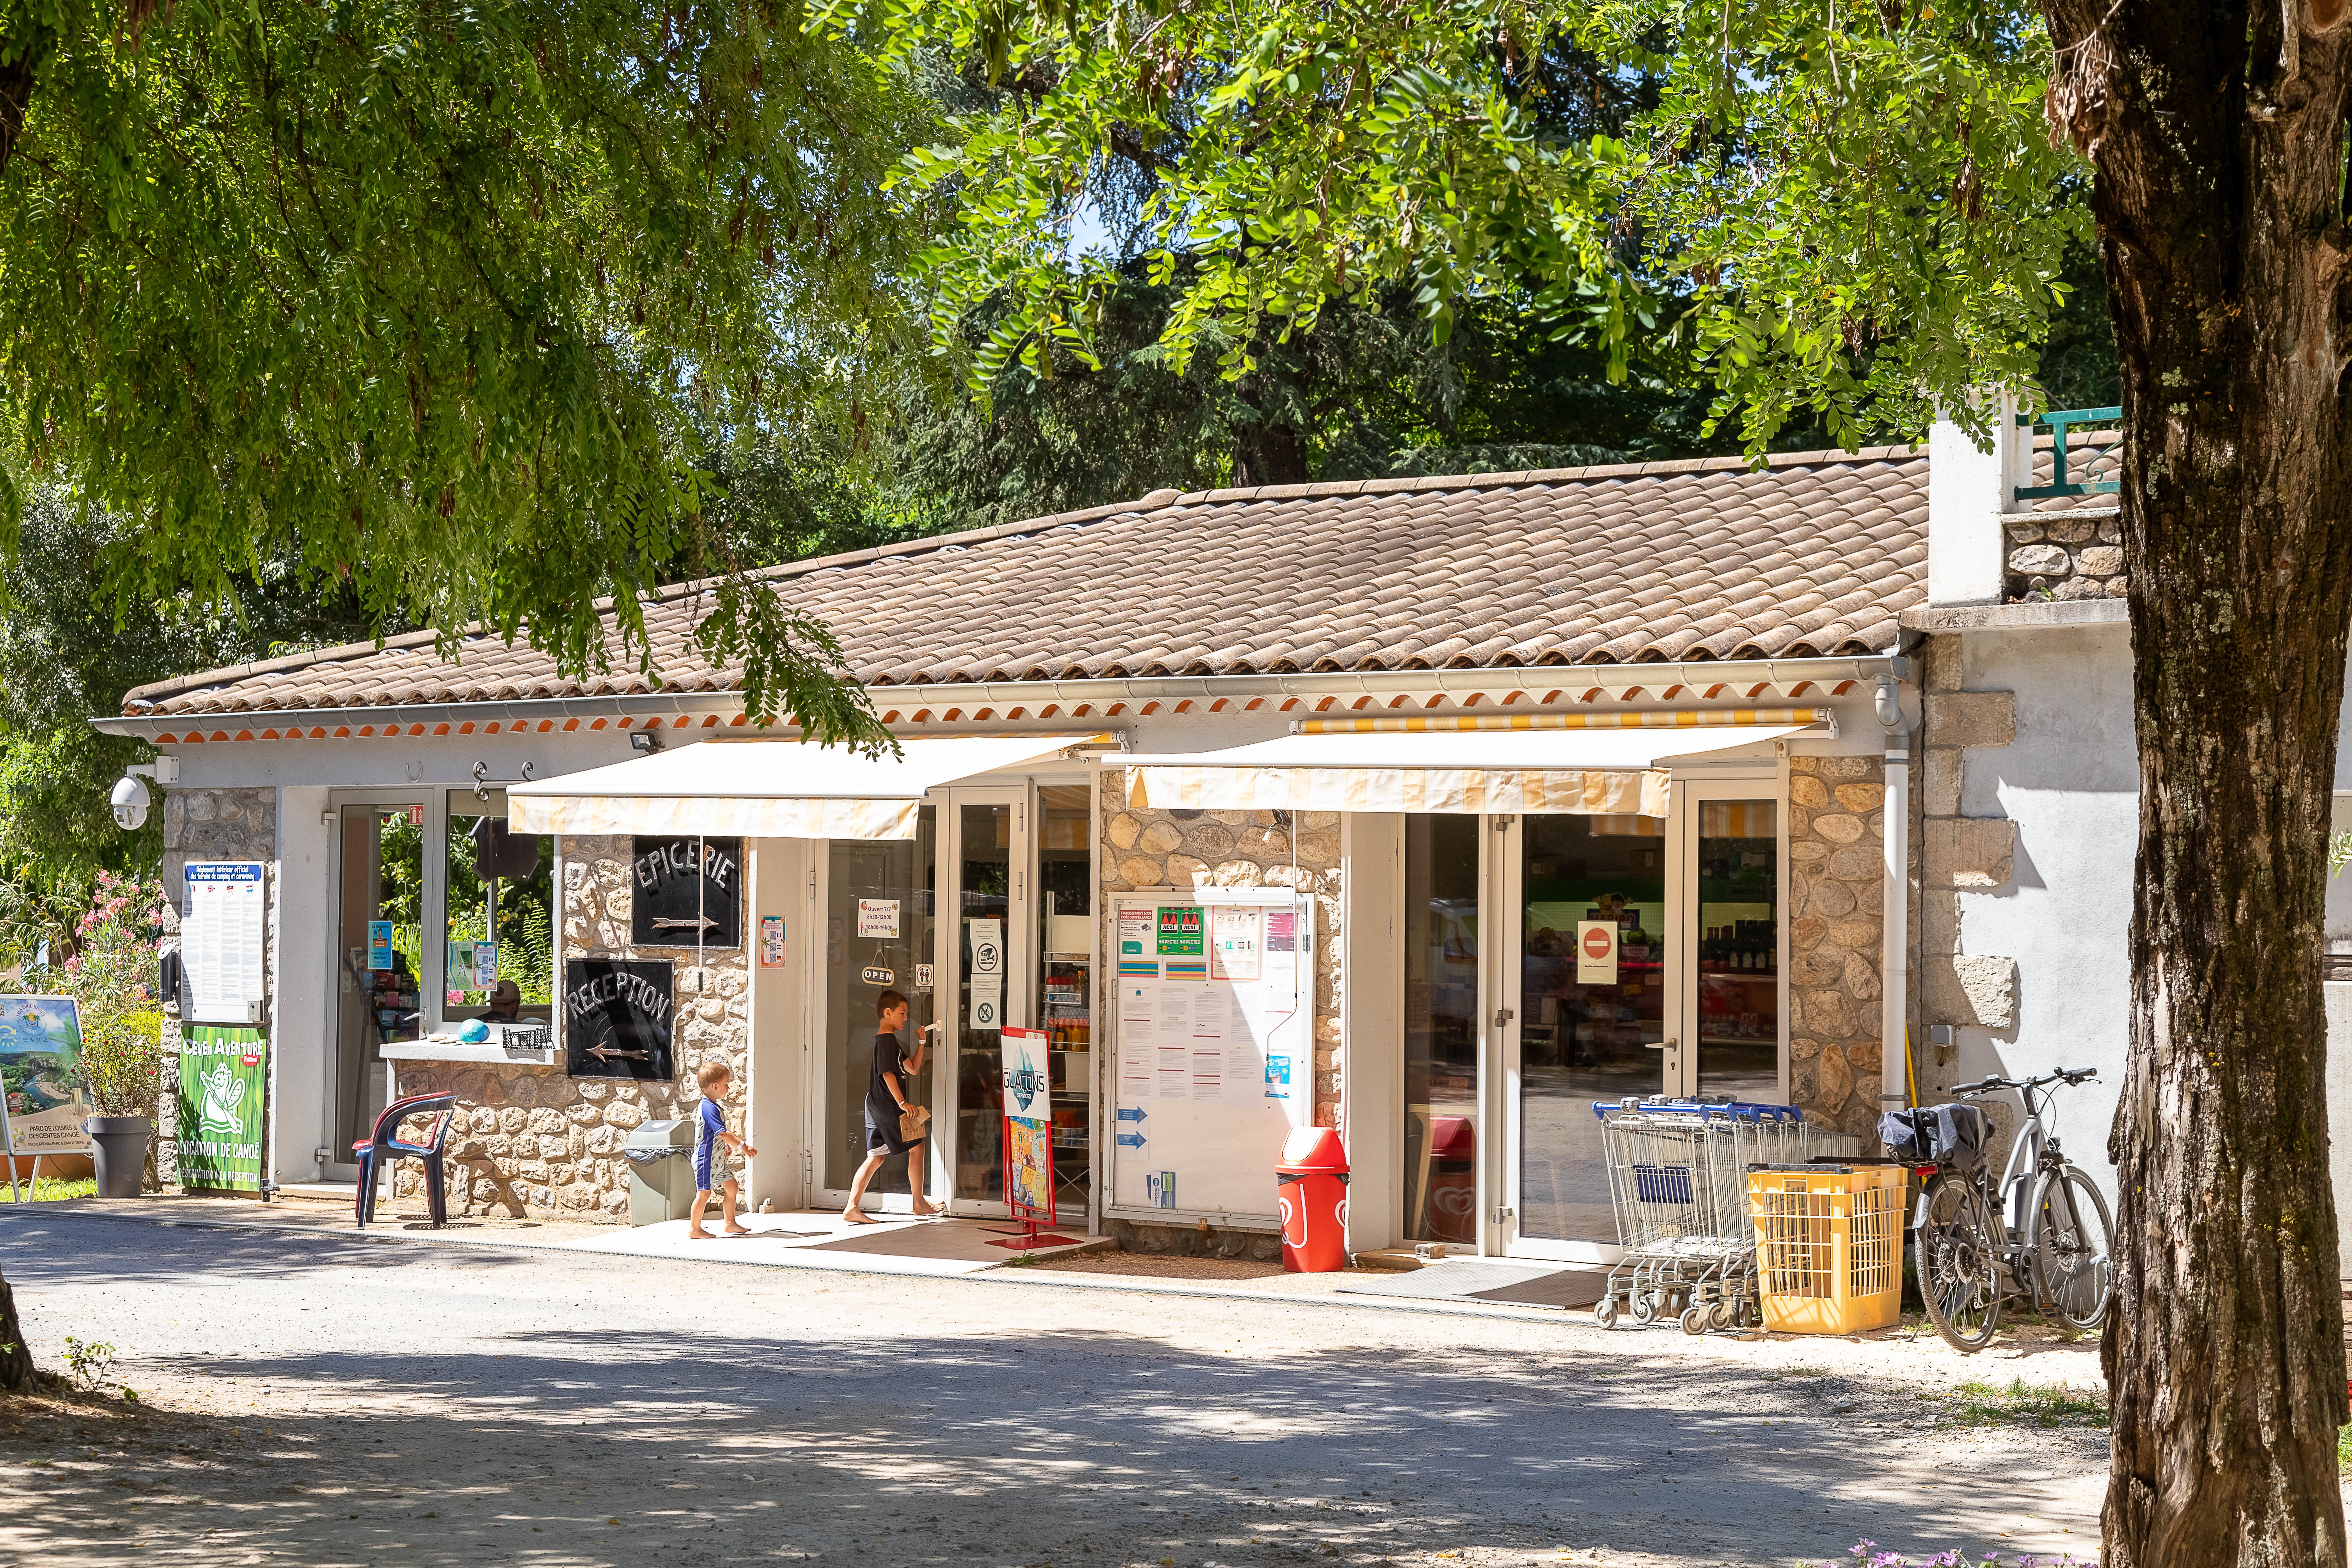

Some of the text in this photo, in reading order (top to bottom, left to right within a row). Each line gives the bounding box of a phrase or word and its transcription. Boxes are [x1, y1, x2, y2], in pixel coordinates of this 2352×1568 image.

[635, 840, 735, 888] EPICERIE
[236, 873, 255, 881] caravaning
[864, 970, 892, 981] OPEN
[566, 972, 669, 1022] RECEPTION
[33, 1005, 46, 1017] DOUCE
[1003, 1071, 1044, 1092] GLAÇONS
[179, 1140, 260, 1160] LOCATION DE CANOË
[178, 1167, 213, 1180] RÉSERVATION
[220, 1170, 226, 1181] LA
[228, 1169, 257, 1183] RÉCEPTION
